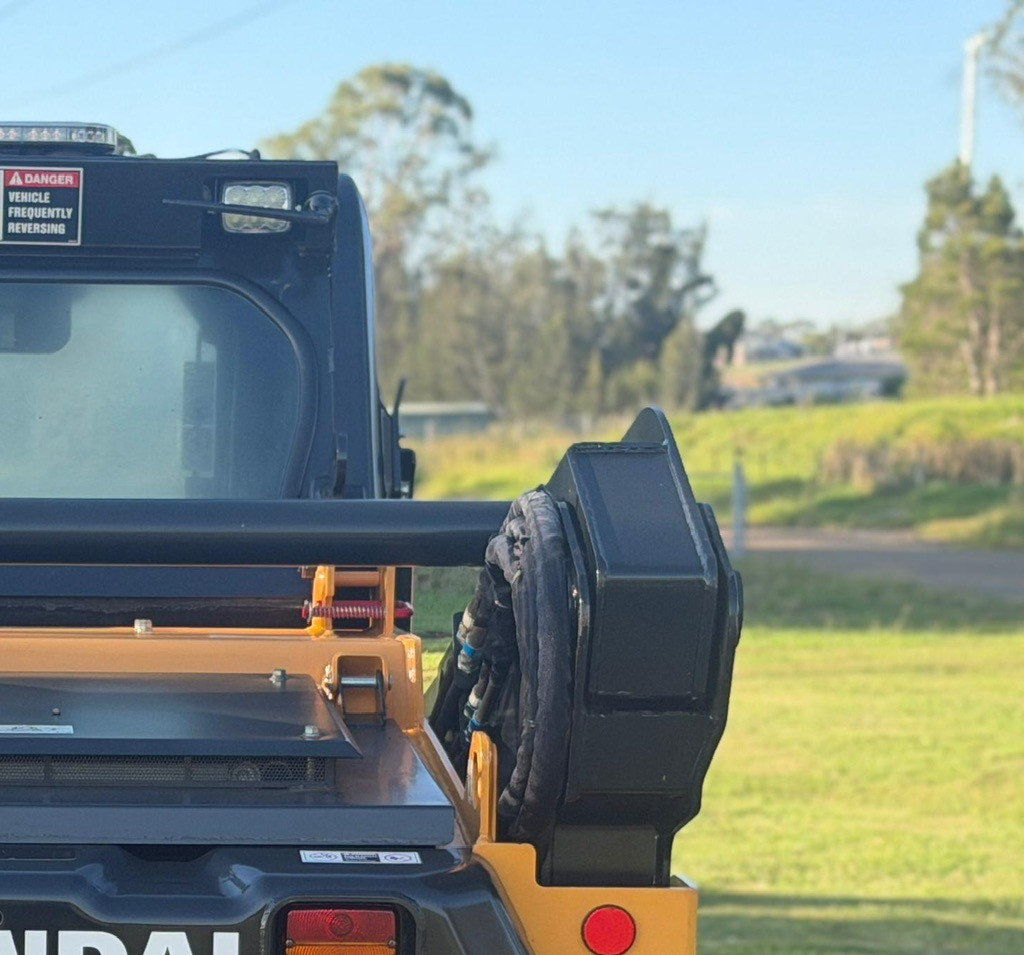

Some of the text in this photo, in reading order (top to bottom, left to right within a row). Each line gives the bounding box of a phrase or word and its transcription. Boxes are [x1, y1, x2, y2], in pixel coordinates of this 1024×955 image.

[24, 174, 74, 185] DANGER
[8, 191, 50, 203] VEHICLE
[8, 207, 73, 220] FREQUENTLY
[8, 222, 65, 235] REVERSING
